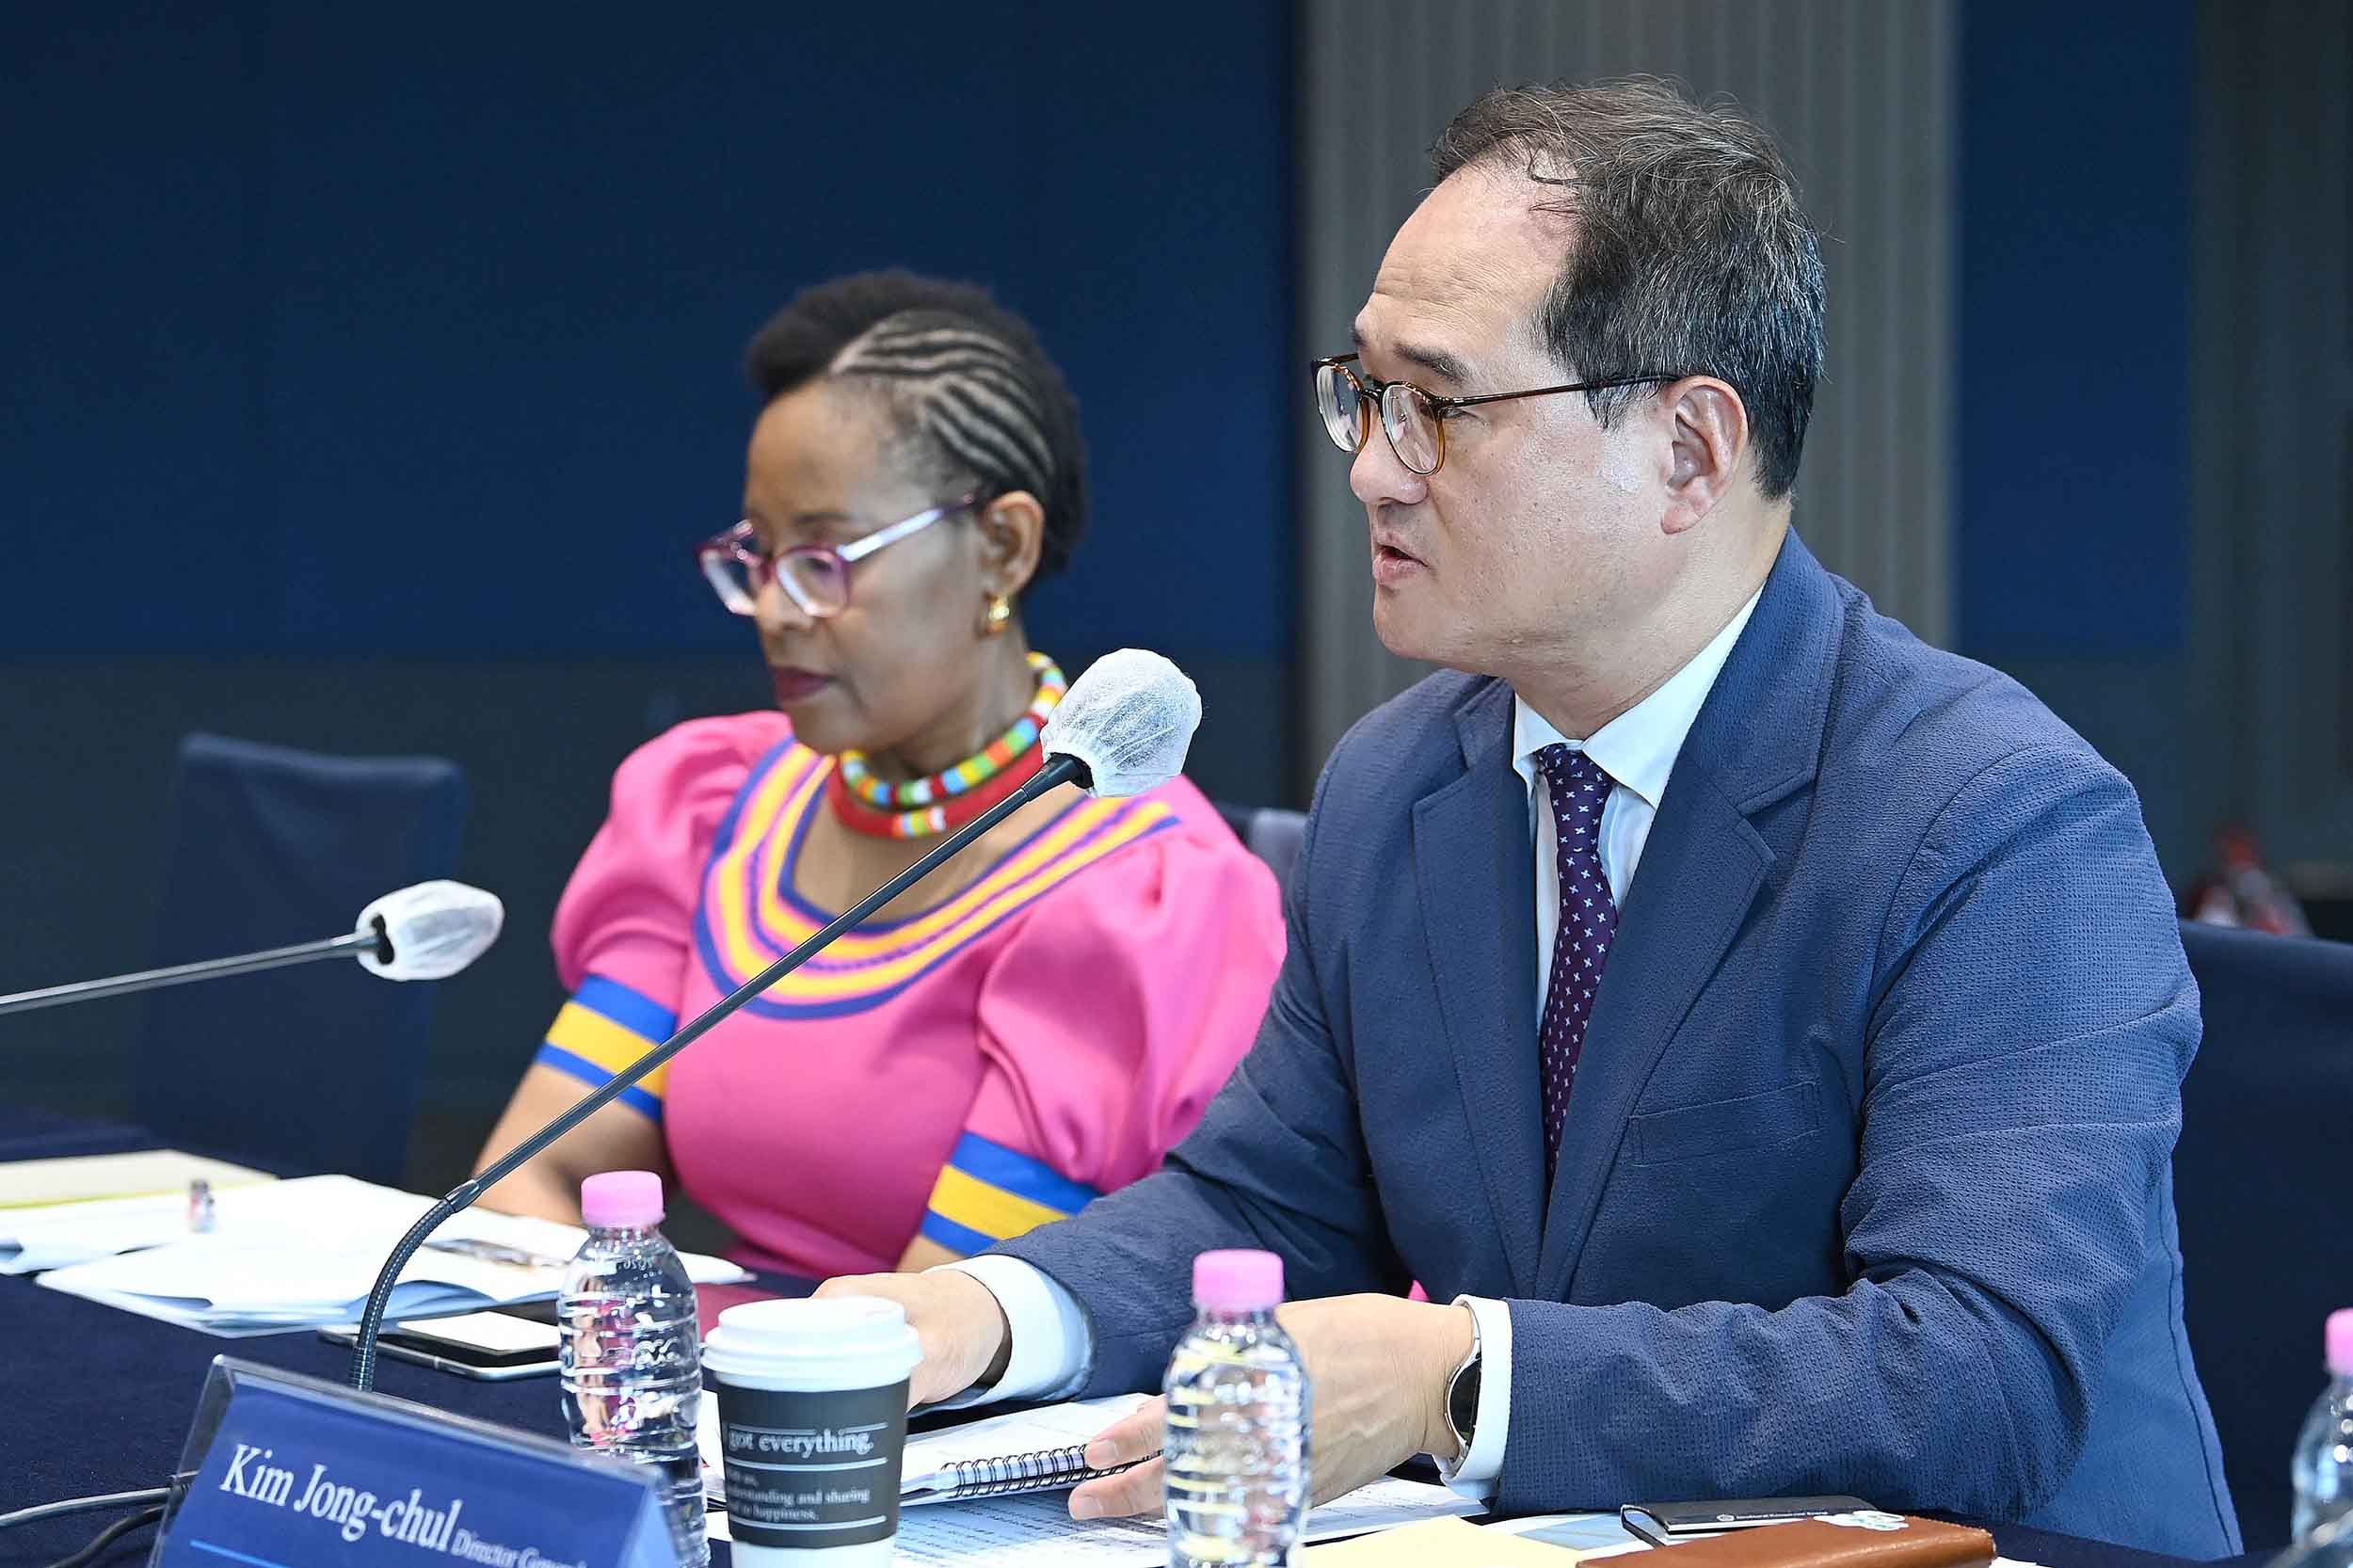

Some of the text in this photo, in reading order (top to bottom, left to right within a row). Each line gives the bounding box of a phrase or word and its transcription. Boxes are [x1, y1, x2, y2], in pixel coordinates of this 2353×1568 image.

[759, 1428, 873, 1459] everything.
[219, 1443, 295, 1507] Kim
[293, 1463, 463, 1553] Jong-chul
[796, 1489, 823, 1505] and
[824, 1486, 871, 1504] sharing
